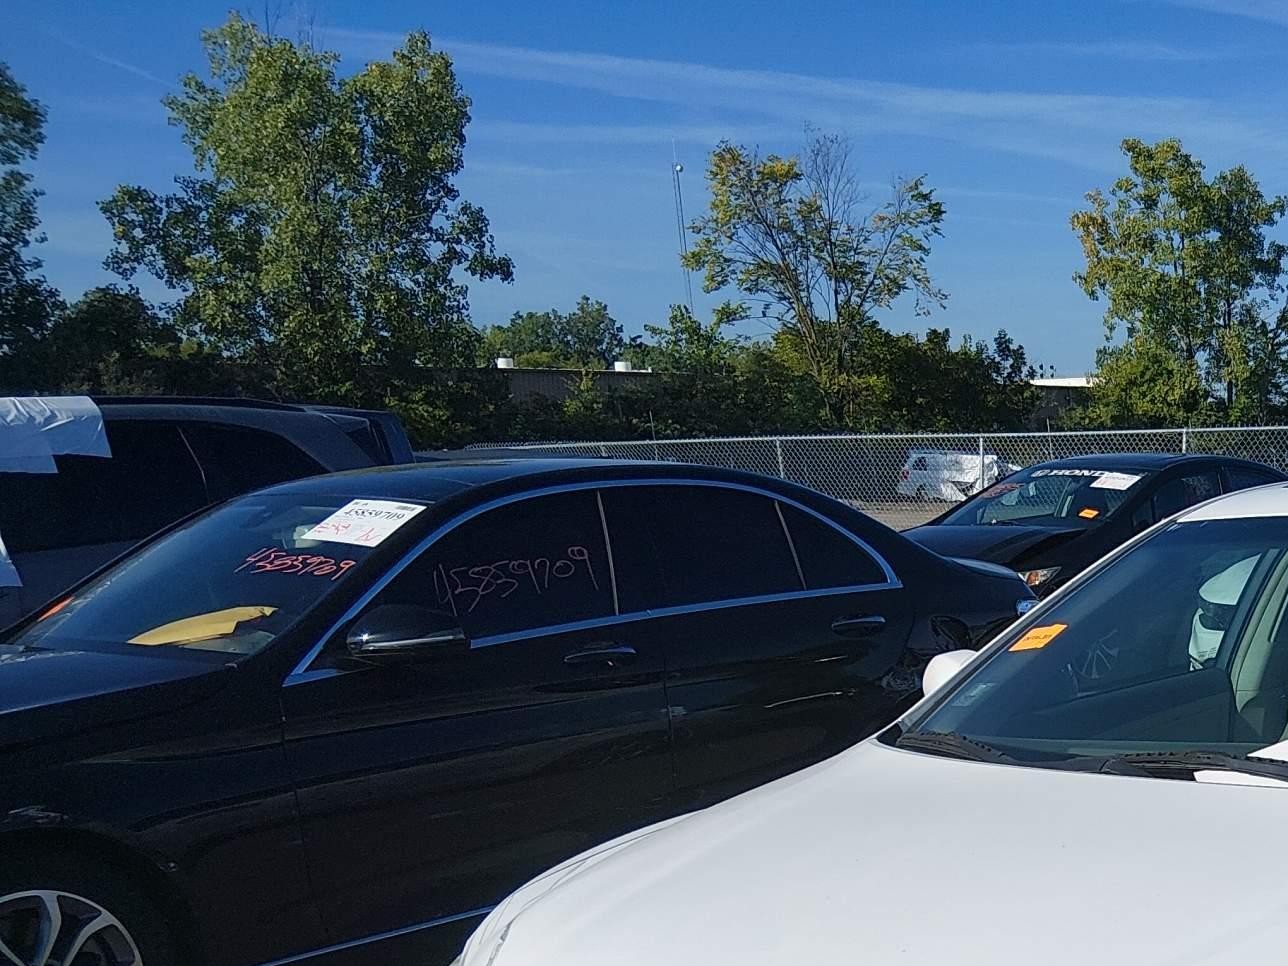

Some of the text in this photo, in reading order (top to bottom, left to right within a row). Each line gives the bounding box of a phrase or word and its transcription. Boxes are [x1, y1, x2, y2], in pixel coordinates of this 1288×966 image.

[1047, 469, 1116, 478] HOND
[233, 547, 357, 581] 45859709
[433, 545, 600, 617] 45859709
